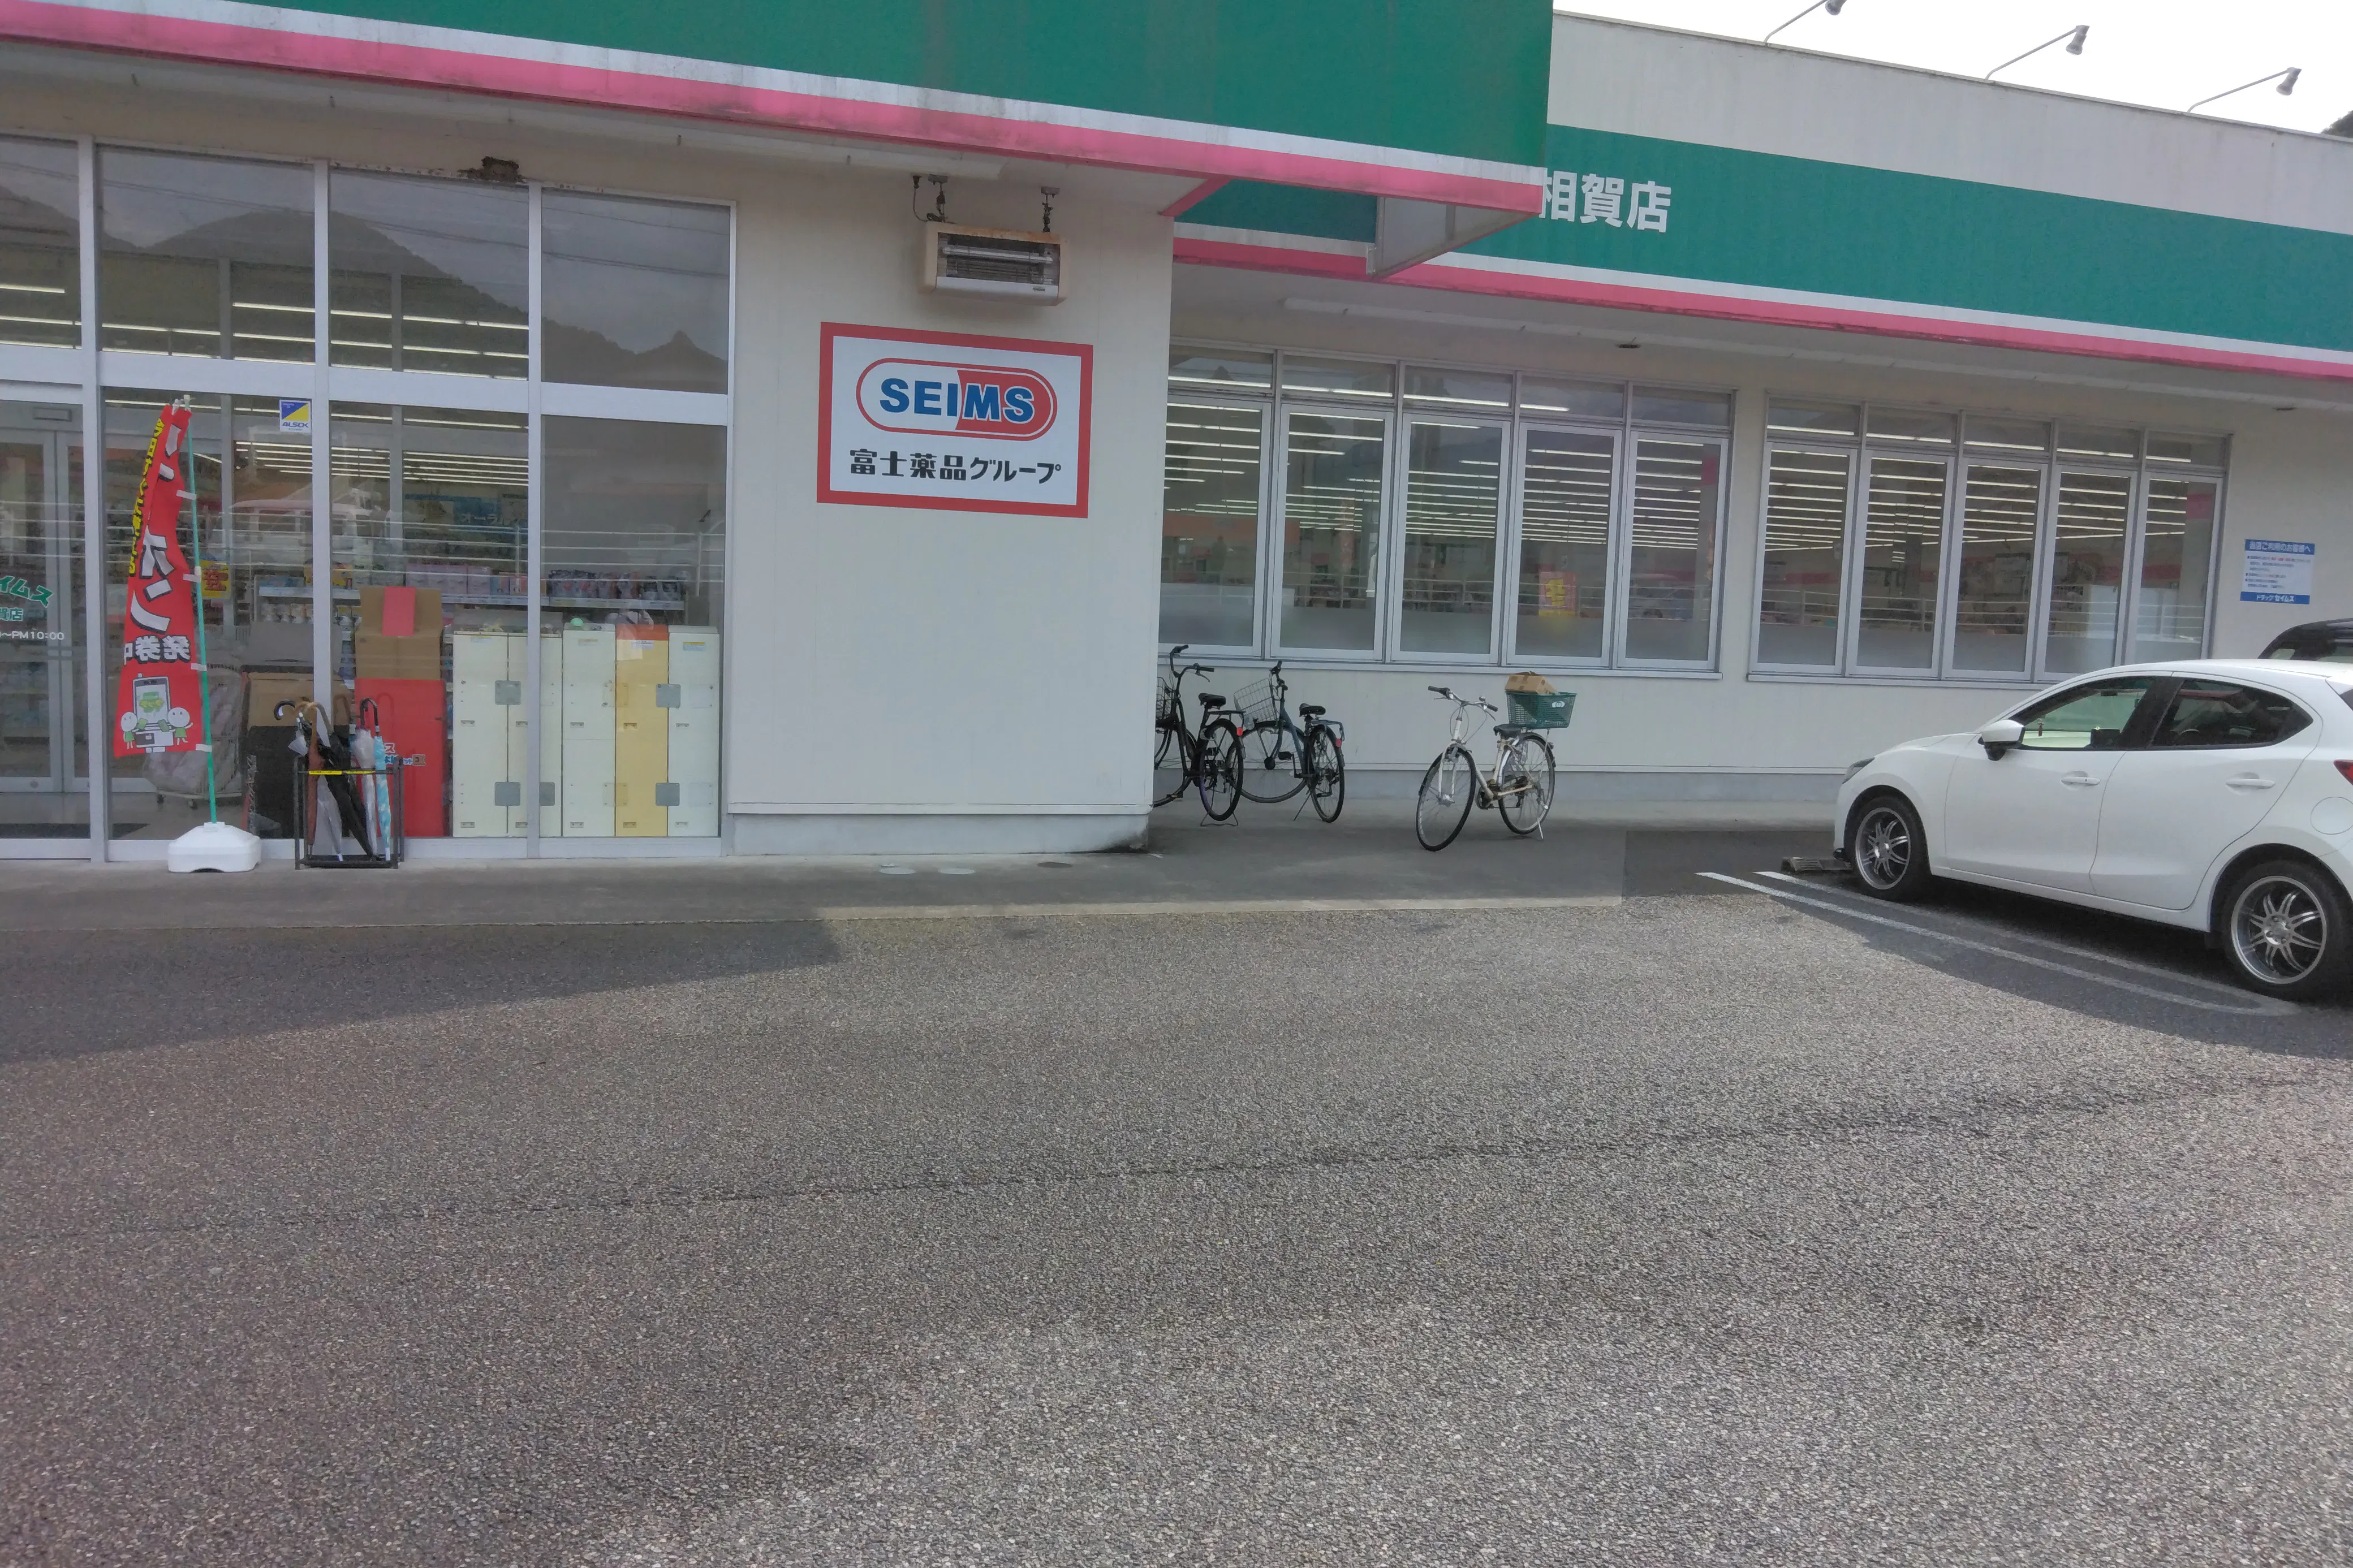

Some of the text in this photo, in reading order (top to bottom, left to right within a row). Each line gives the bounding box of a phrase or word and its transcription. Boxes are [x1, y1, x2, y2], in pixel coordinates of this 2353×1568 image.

[1538, 170, 1671, 233] 相賀店
[880, 378, 1035, 423] SEIMS
[850, 448, 1062, 485] 富士薬品グループ
